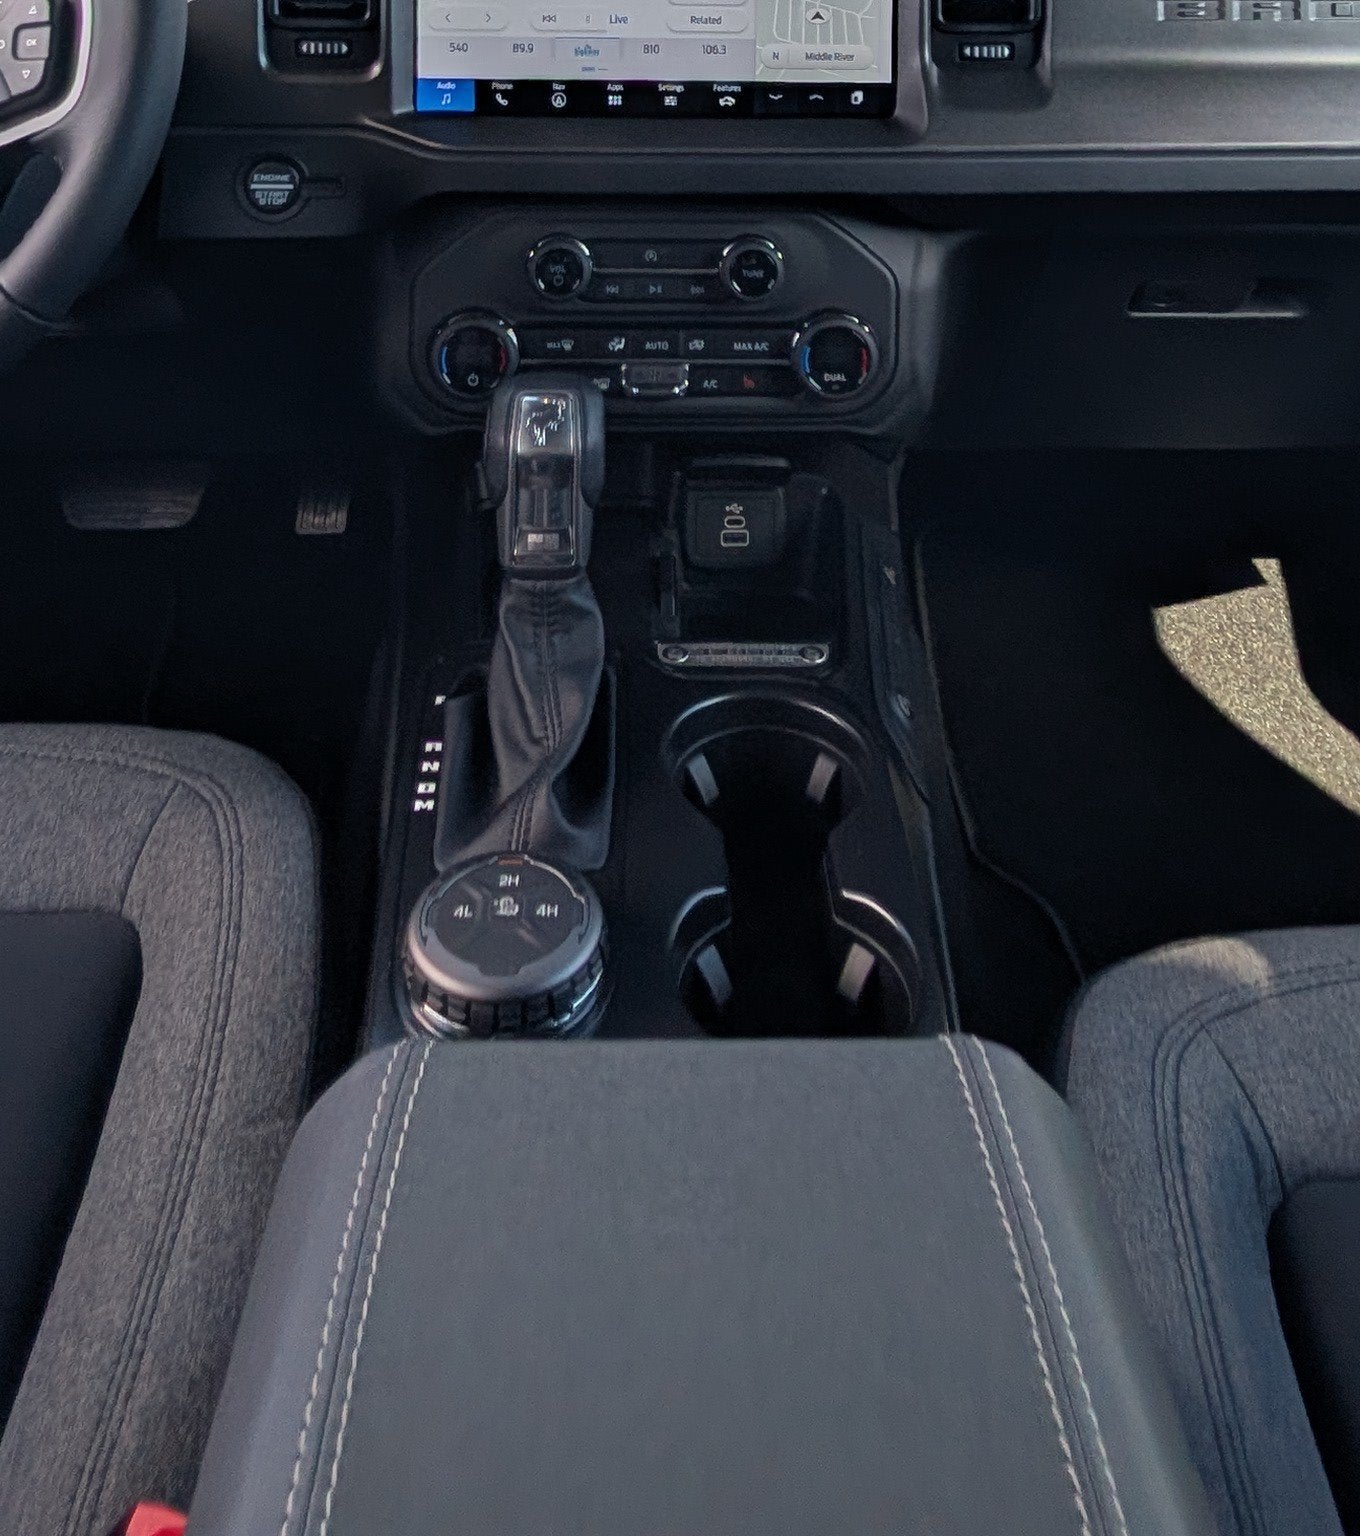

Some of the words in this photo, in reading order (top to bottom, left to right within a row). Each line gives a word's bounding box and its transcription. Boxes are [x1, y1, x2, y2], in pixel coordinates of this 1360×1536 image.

[609, 14, 628, 24] Live
[690, 16, 722, 26] Related
[449, 42, 469, 53] 540
[512, 43, 534, 53] 89.9
[702, 44, 727, 55] 106.3
[772, 52, 780, 61] N
[805, 52, 832, 62] Middle
[834, 52, 855, 62] River
[436, 81, 456, 90] Audio
[491, 82, 513, 90] Phone
[607, 83, 624, 92] Apps
[658, 83, 685, 93] Settings
[713, 83, 742, 92] Features
[645, 341, 669, 350] AUTO
[734, 342, 753, 351] MAX
[754, 342, 770, 351] A/C
[703, 379, 718, 389] A/C
[421, 761, 440, 773] N
[413, 800, 434, 812] M
[499, 874, 520, 887] 2H
[453, 905, 474, 919] 4L
[535, 903, 559, 918] 4H
